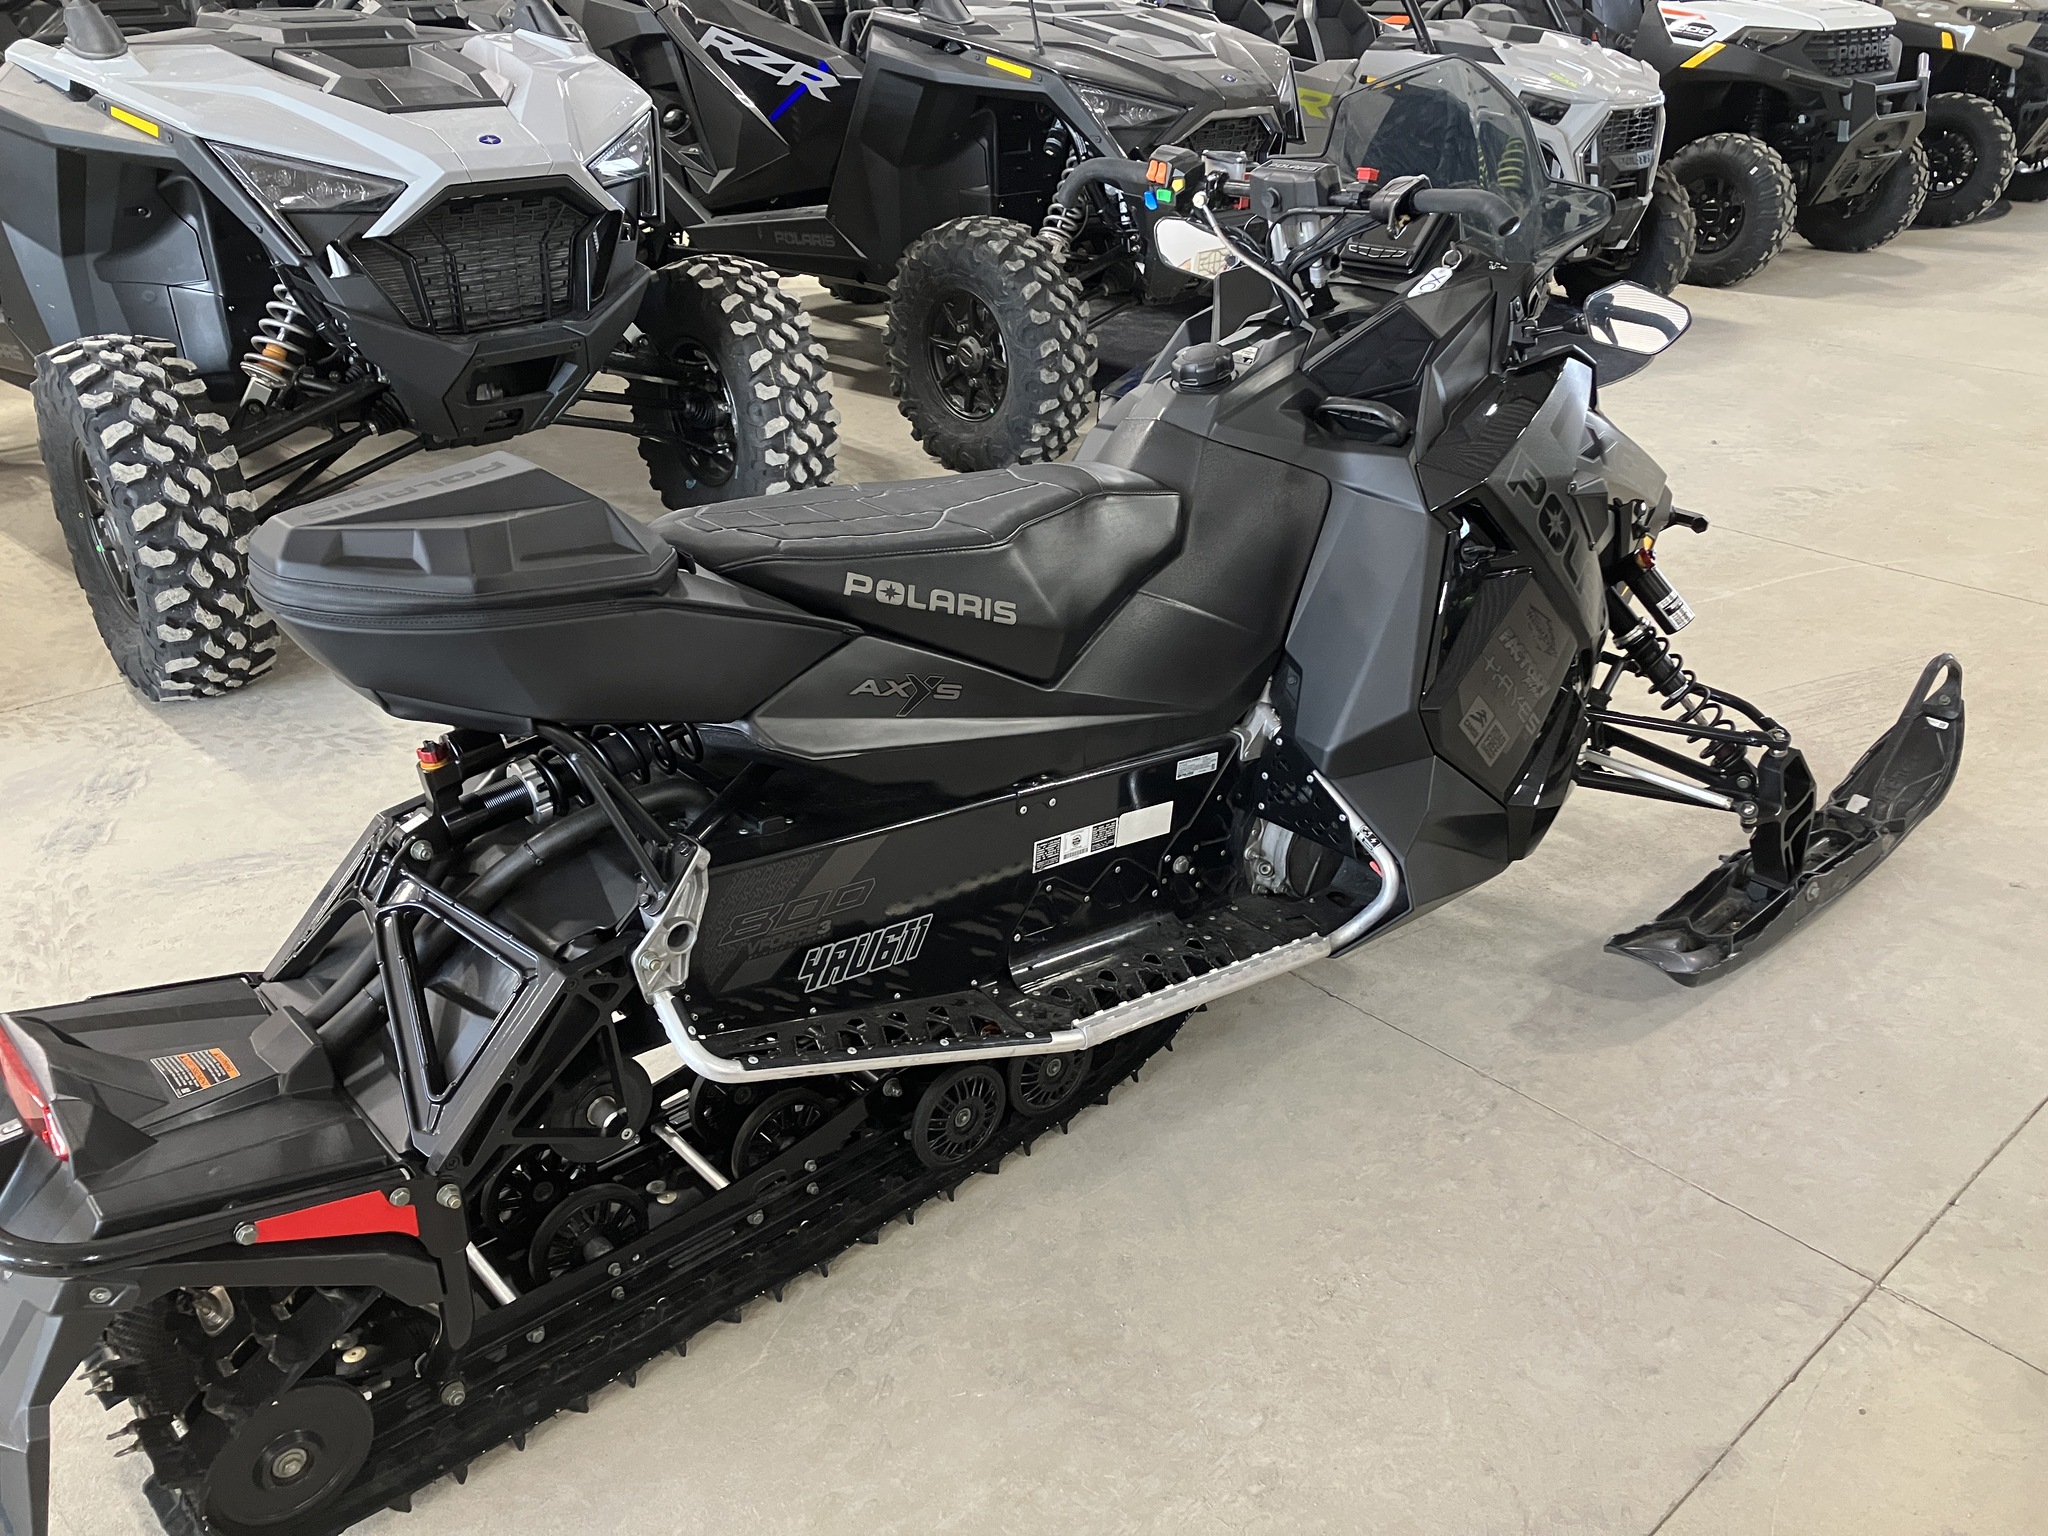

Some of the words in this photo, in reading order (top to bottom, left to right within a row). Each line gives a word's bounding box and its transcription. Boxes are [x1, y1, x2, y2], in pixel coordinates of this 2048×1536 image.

[698, 26, 841, 102] RZR
[1838, 41, 1891, 62] POLARIS
[774, 231, 836, 248] POLARIS
[303, 461, 507, 520] POLARIS
[843, 572, 1017, 626] POLARIS
[850, 673, 963, 718] AXYS
[1482, 655, 1541, 735] HAYES
[718, 877, 876, 946] 800
